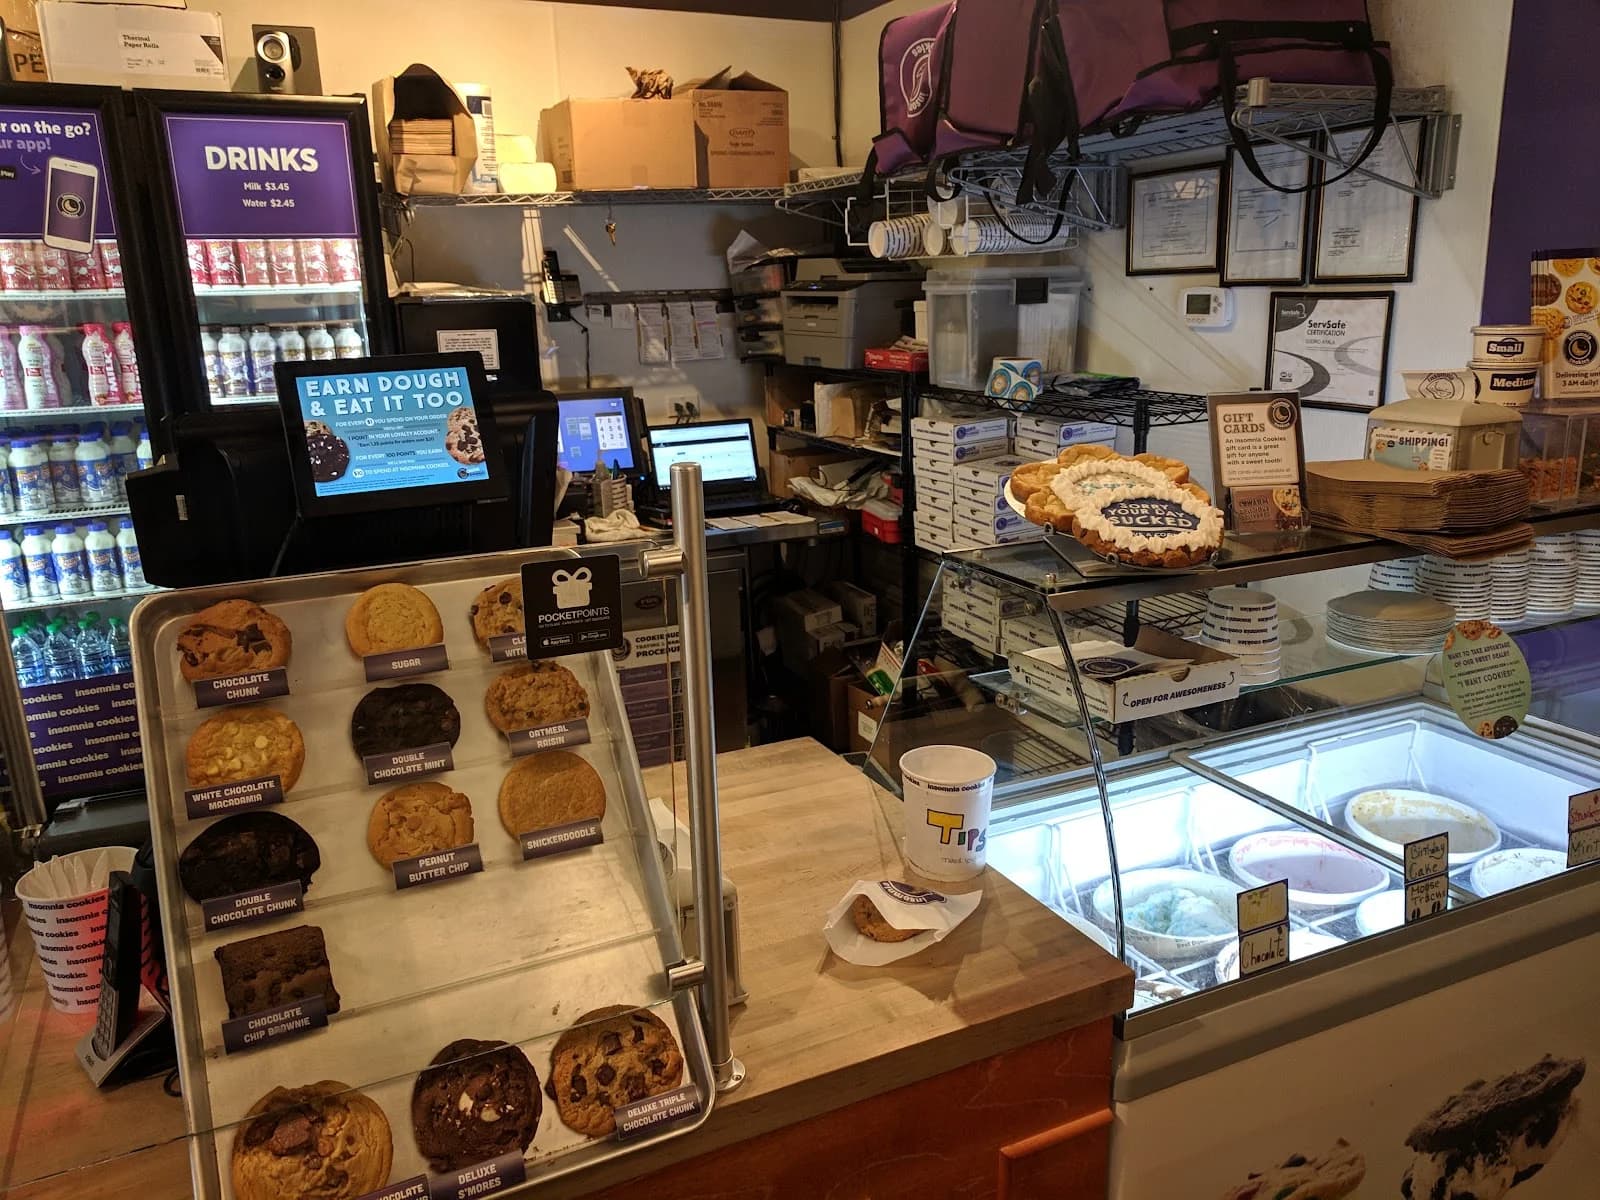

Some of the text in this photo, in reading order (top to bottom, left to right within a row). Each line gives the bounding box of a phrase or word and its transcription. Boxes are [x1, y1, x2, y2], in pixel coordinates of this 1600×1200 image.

[123, 34, 150, 42] Thermal
[10, 121, 91, 138] on the go?
[17, 137, 52, 152] app!
[204, 145, 319, 172] DRINKS
[243, 182, 290, 191] Milk $3.45
[242, 199, 295, 208] Water $2.45
[1307, 320, 1347, 329] ServSafe
[1306, 329, 1346, 337] CERTIFICATION
[1488, 342, 1523, 353] Small
[305, 371, 461, 397] EARN DOUGH
[310, 391, 463, 417] & EAT IT TOO
[1223, 412, 1254, 423] GIFT
[1223, 423, 1265, 434] CARDS
[1398, 436, 1448, 447] SHIPPING!
[1108, 508, 1185, 518] YOUR DAY
[1119, 502, 1168, 510] SORRY
[1109, 515, 1193, 527] SUCKED
[538, 606, 610, 624] POCKETPOINTS
[635, 633, 665, 643] COOKIE
[391, 657, 421, 670] SUGAR
[213, 672, 270, 689] CHOCOLATE
[1464, 677, 1482, 686] WANT
[23, 683, 121, 705] cookies insomnia
[226, 685, 260, 700] CHUNK
[1130, 681, 1227, 708] OPEN FOR AWESOMENESS
[59, 703, 100, 716] cookies
[48, 714, 136, 736] insomnia cookies
[528, 724, 569, 739] OATMEAL
[33, 731, 130, 755] cookies insomnia
[536, 735, 565, 748] RAISIN
[69, 751, 109, 765] cookies
[392, 752, 425, 765] DOUBLE
[58, 769, 104, 784] insomnia
[373, 759, 446, 779] CHOCOLATE MINT
[191, 780, 275, 803] WHITE CHOCOLATE
[927, 783, 960, 792] insomnia
[208, 793, 263, 811] MACADAMIA
[526, 826, 597, 850] SNICKERDOODLE
[418, 852, 456, 868] PEANUT
[408, 861, 470, 883] BUTTER CHIP
[1409, 863, 1438, 878] Cake
[1411, 880, 1440, 896] Moose
[66, 895, 106, 909] cookies
[235, 893, 271, 908] DOUBLE
[56, 911, 100, 924] insomnia
[210, 898, 298, 925] CHOCOLATE CHUNK
[45, 930, 79, 938] cookies
[1242, 936, 1285, 969] Chocolate
[248, 1006, 302, 1030] CHOCOLATE
[243, 1016, 311, 1043] CHIP BROWNIE
[626, 1092, 687, 1119] DELUXE TRIPLE
[622, 1101, 697, 1133] CHOCOLATE CHUNK
[457, 1163, 497, 1185] DELUXE
[457, 1177, 502, 1199] S'MORES
